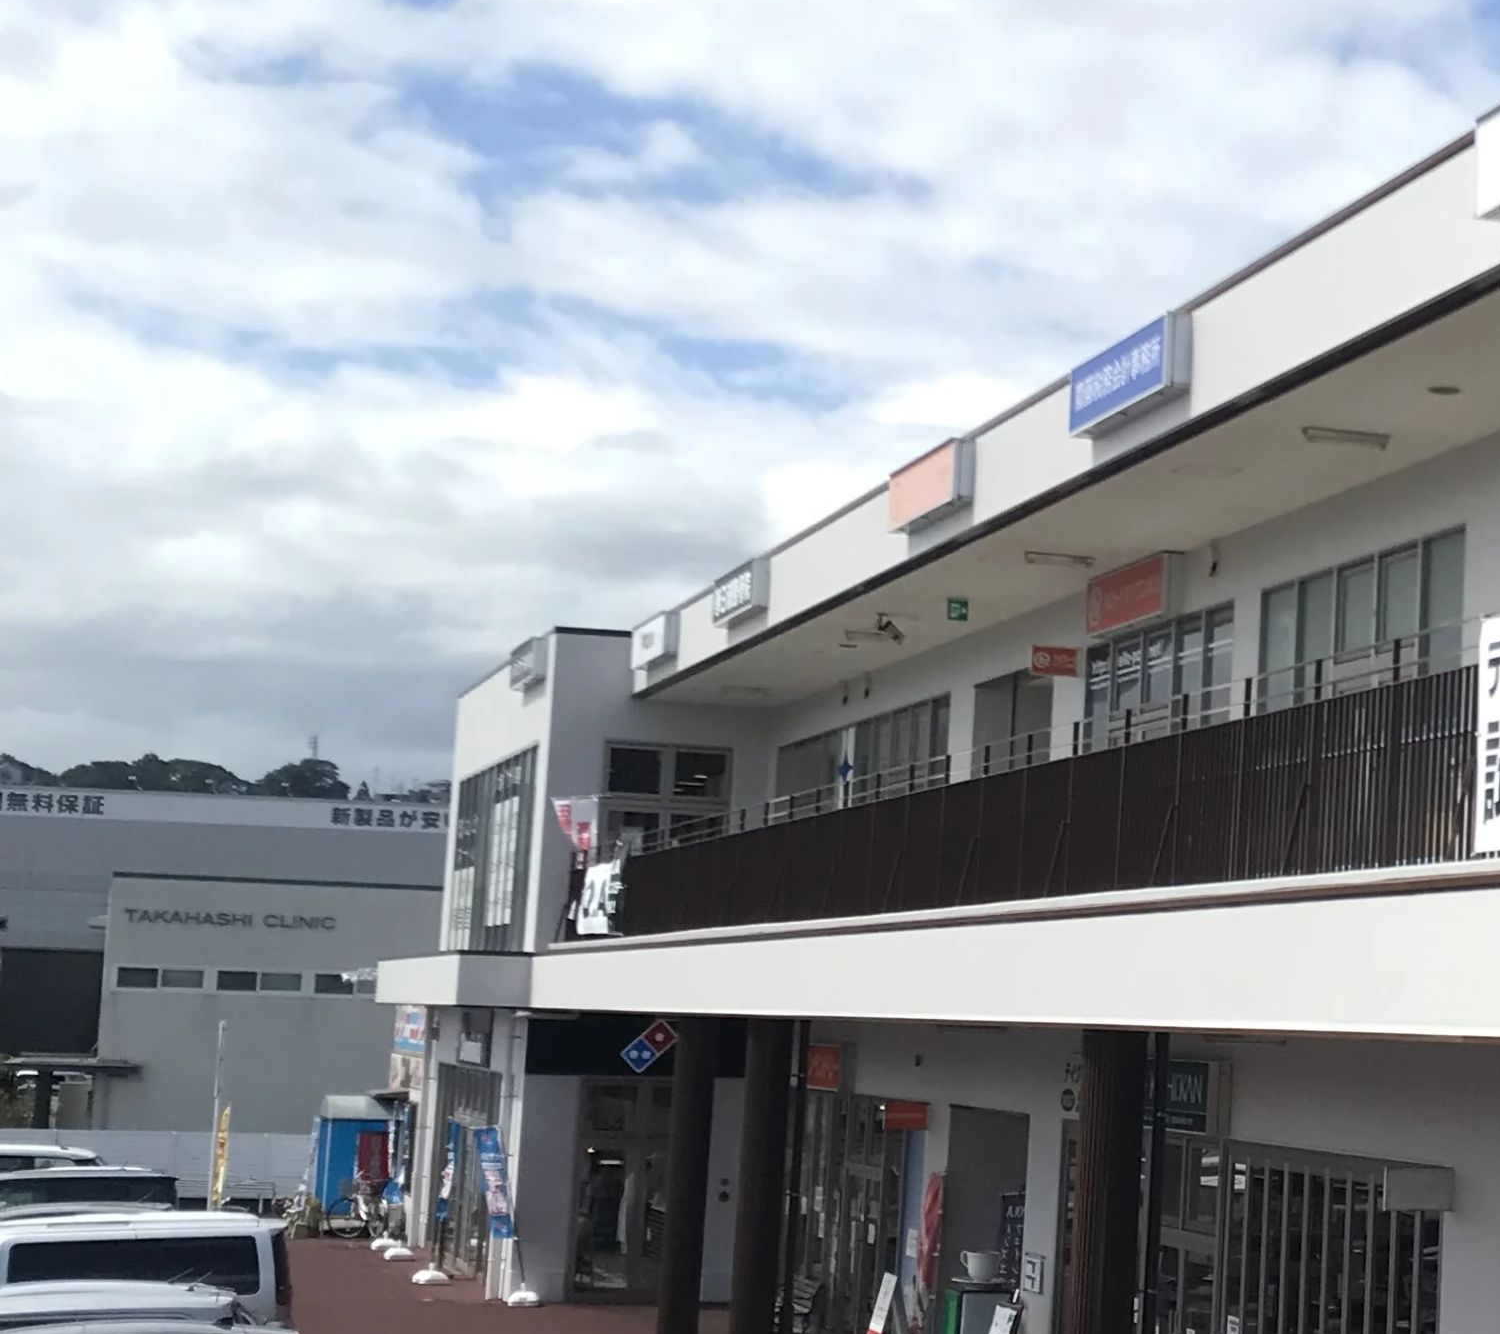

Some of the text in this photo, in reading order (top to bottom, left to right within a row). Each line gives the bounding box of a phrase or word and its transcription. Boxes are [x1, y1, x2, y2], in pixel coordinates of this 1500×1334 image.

[0, 791, 104, 816] 無料保証
[125, 907, 336, 930] TAKAHASHI CLINIC
